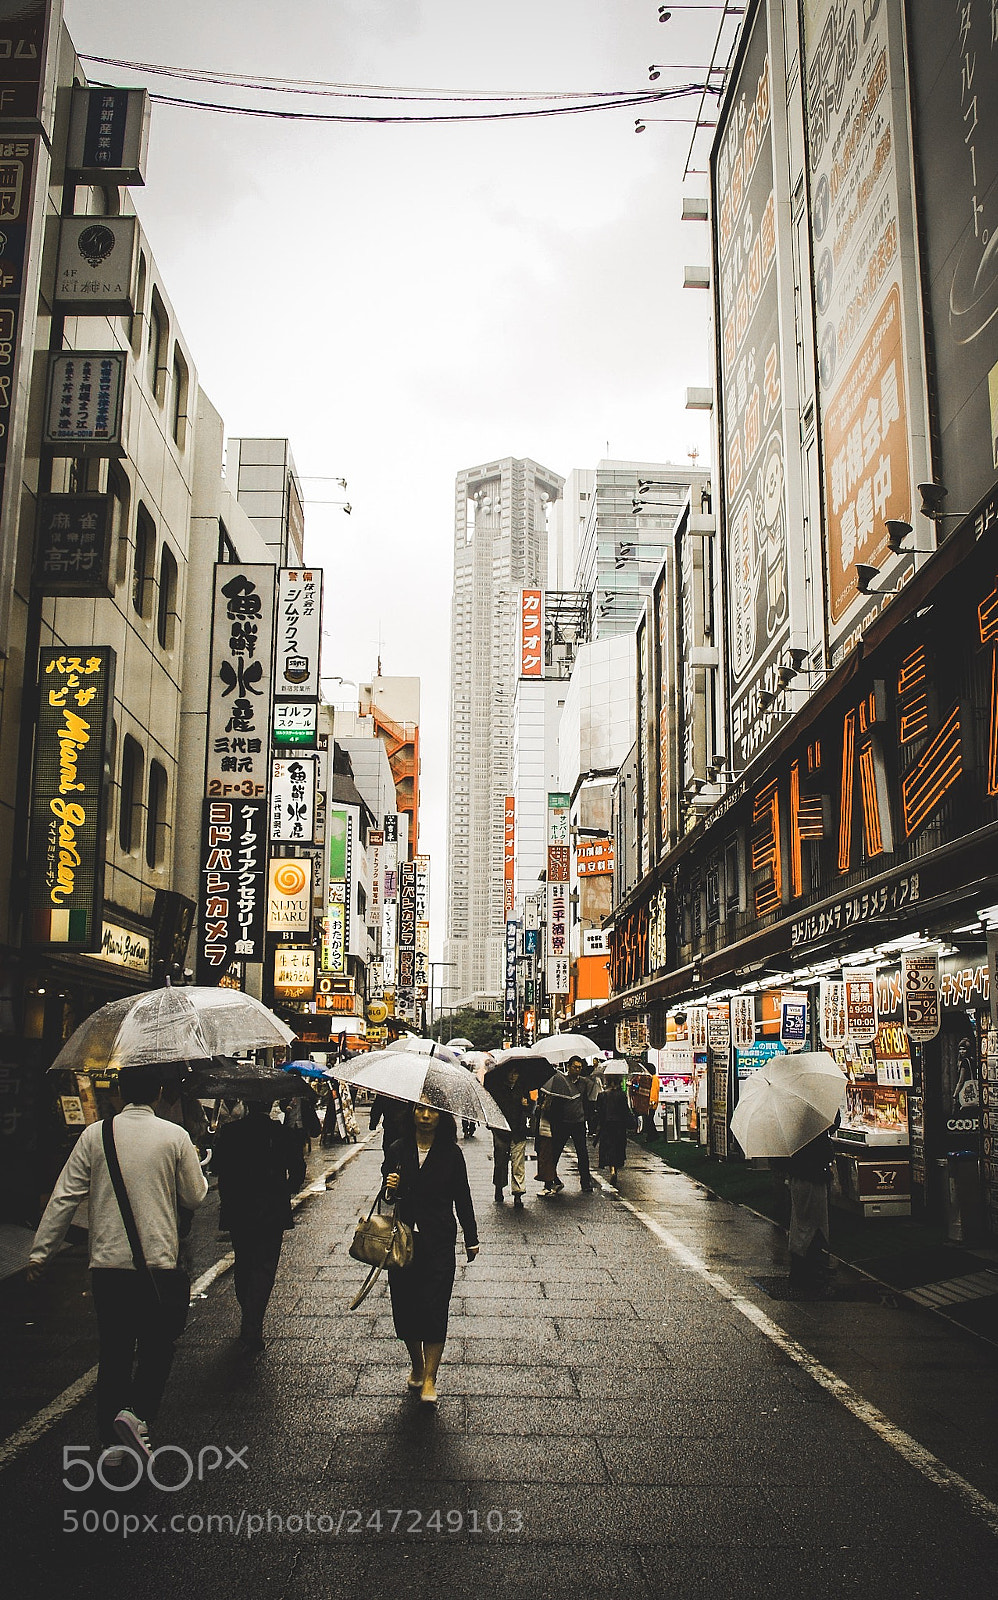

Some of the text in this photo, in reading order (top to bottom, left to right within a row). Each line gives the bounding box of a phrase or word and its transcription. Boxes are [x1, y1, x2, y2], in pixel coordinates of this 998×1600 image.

[63, 269, 78, 278] 4F
[831, 358, 900, 515] 新規会員
[49, 512, 98, 530] 麻雀
[840, 453, 892, 572] 募集中
[302, 583, 315, 616] 株式会社
[283, 589, 303, 653] シムックス
[522, 595, 541, 670] カラオケ
[220, 574, 264, 733] 魚鮮水産
[46, 656, 102, 673] パスタ
[67, 673, 79, 687] と
[49, 687, 96, 706] ピザ
[278, 706, 312, 717] ゴルフ
[278, 719, 312, 727] スクール
[213, 737, 262, 753] 三代目
[220, 756, 254, 772] 網元
[504, 808, 516, 864] カラオケ
[204, 802, 233, 966] ヨドバシカメラ
[234, 804, 260, 955] ケータイアクセサリー館
[270, 899, 308, 911] NIJYU
[402, 863, 415, 945] ヨドバシカメラ
[270, 911, 307, 922] MARU
[791, 904, 843, 944] ヨドバシカメラ
[282, 931, 294, 940] B1
[331, 920, 343, 970] おたからや
[279, 954, 310, 967] 生そば
[850, 983, 870, 993] 営業
[907, 970, 935, 990] 8%
[854, 1005, 873, 1014] 9:30
[908, 1001, 937, 1022] 5%
[853, 1018, 875, 1027] 10:00
[872, 1170, 897, 1184] Y!
